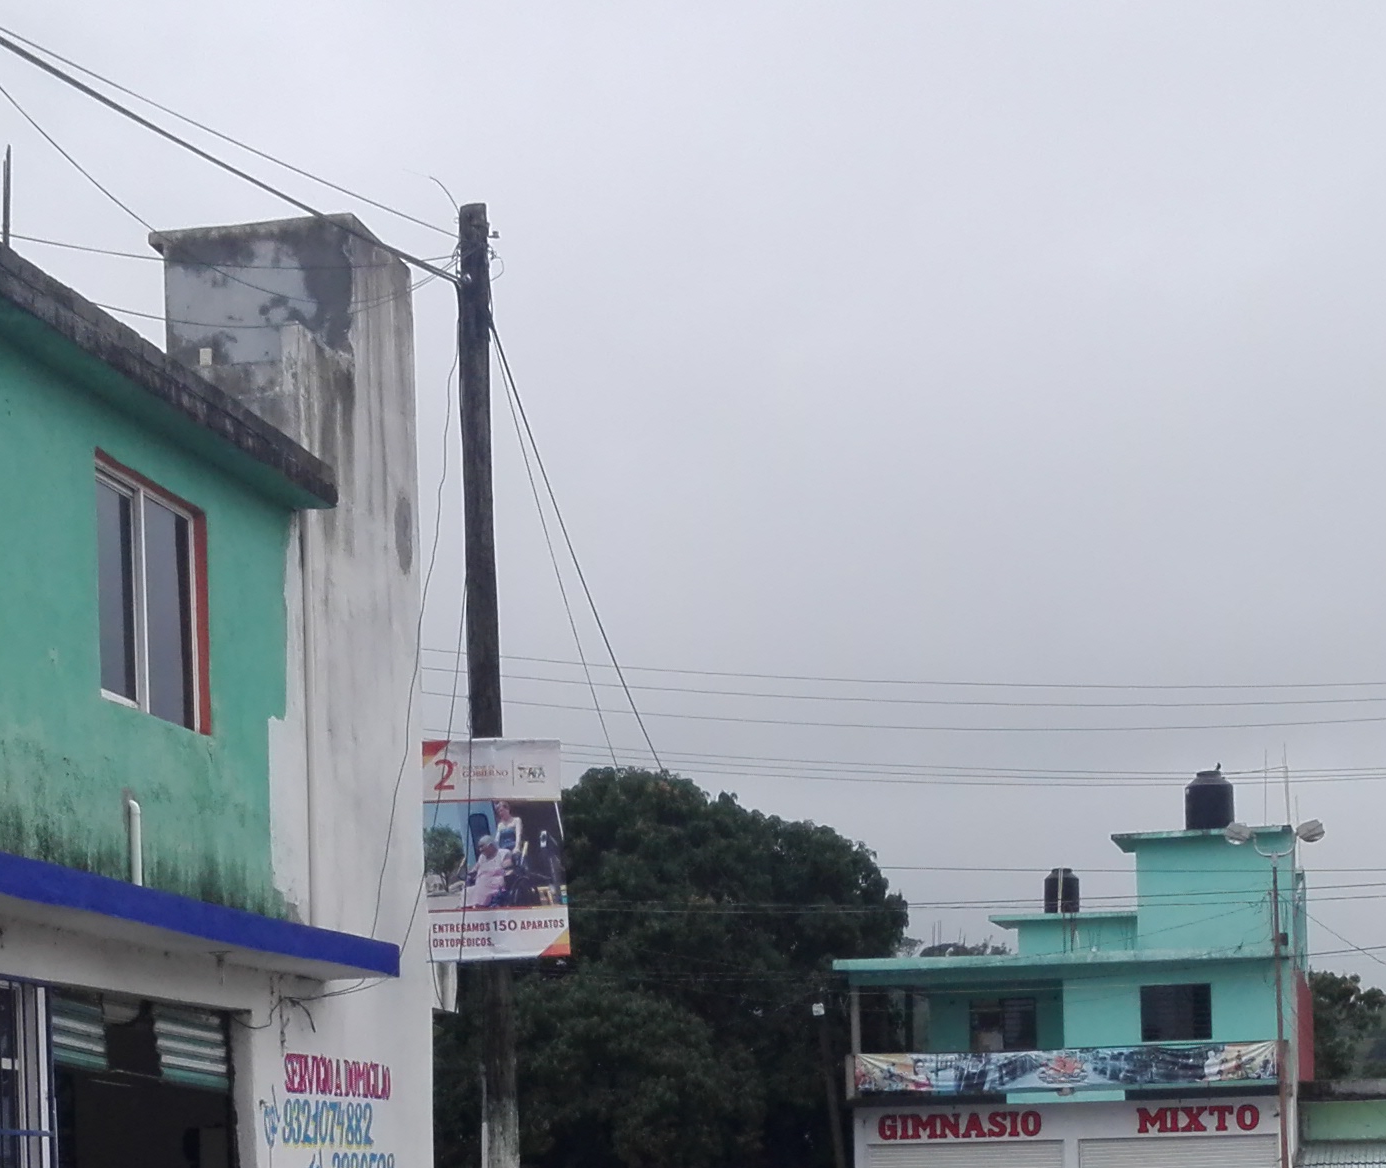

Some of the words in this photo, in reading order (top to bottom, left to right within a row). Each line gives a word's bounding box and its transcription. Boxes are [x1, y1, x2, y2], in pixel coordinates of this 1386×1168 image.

[433, 922, 490, 933] ENTREGAMOS
[493, 920, 517, 931] 150
[520, 919, 565, 930] APARATOS
[334, 1059, 343, 1097] A
[282, 1098, 374, 1147] 9321074882
[878, 1110, 1042, 1141] GIMNASIO
[1136, 1104, 1260, 1133] MIXTO
